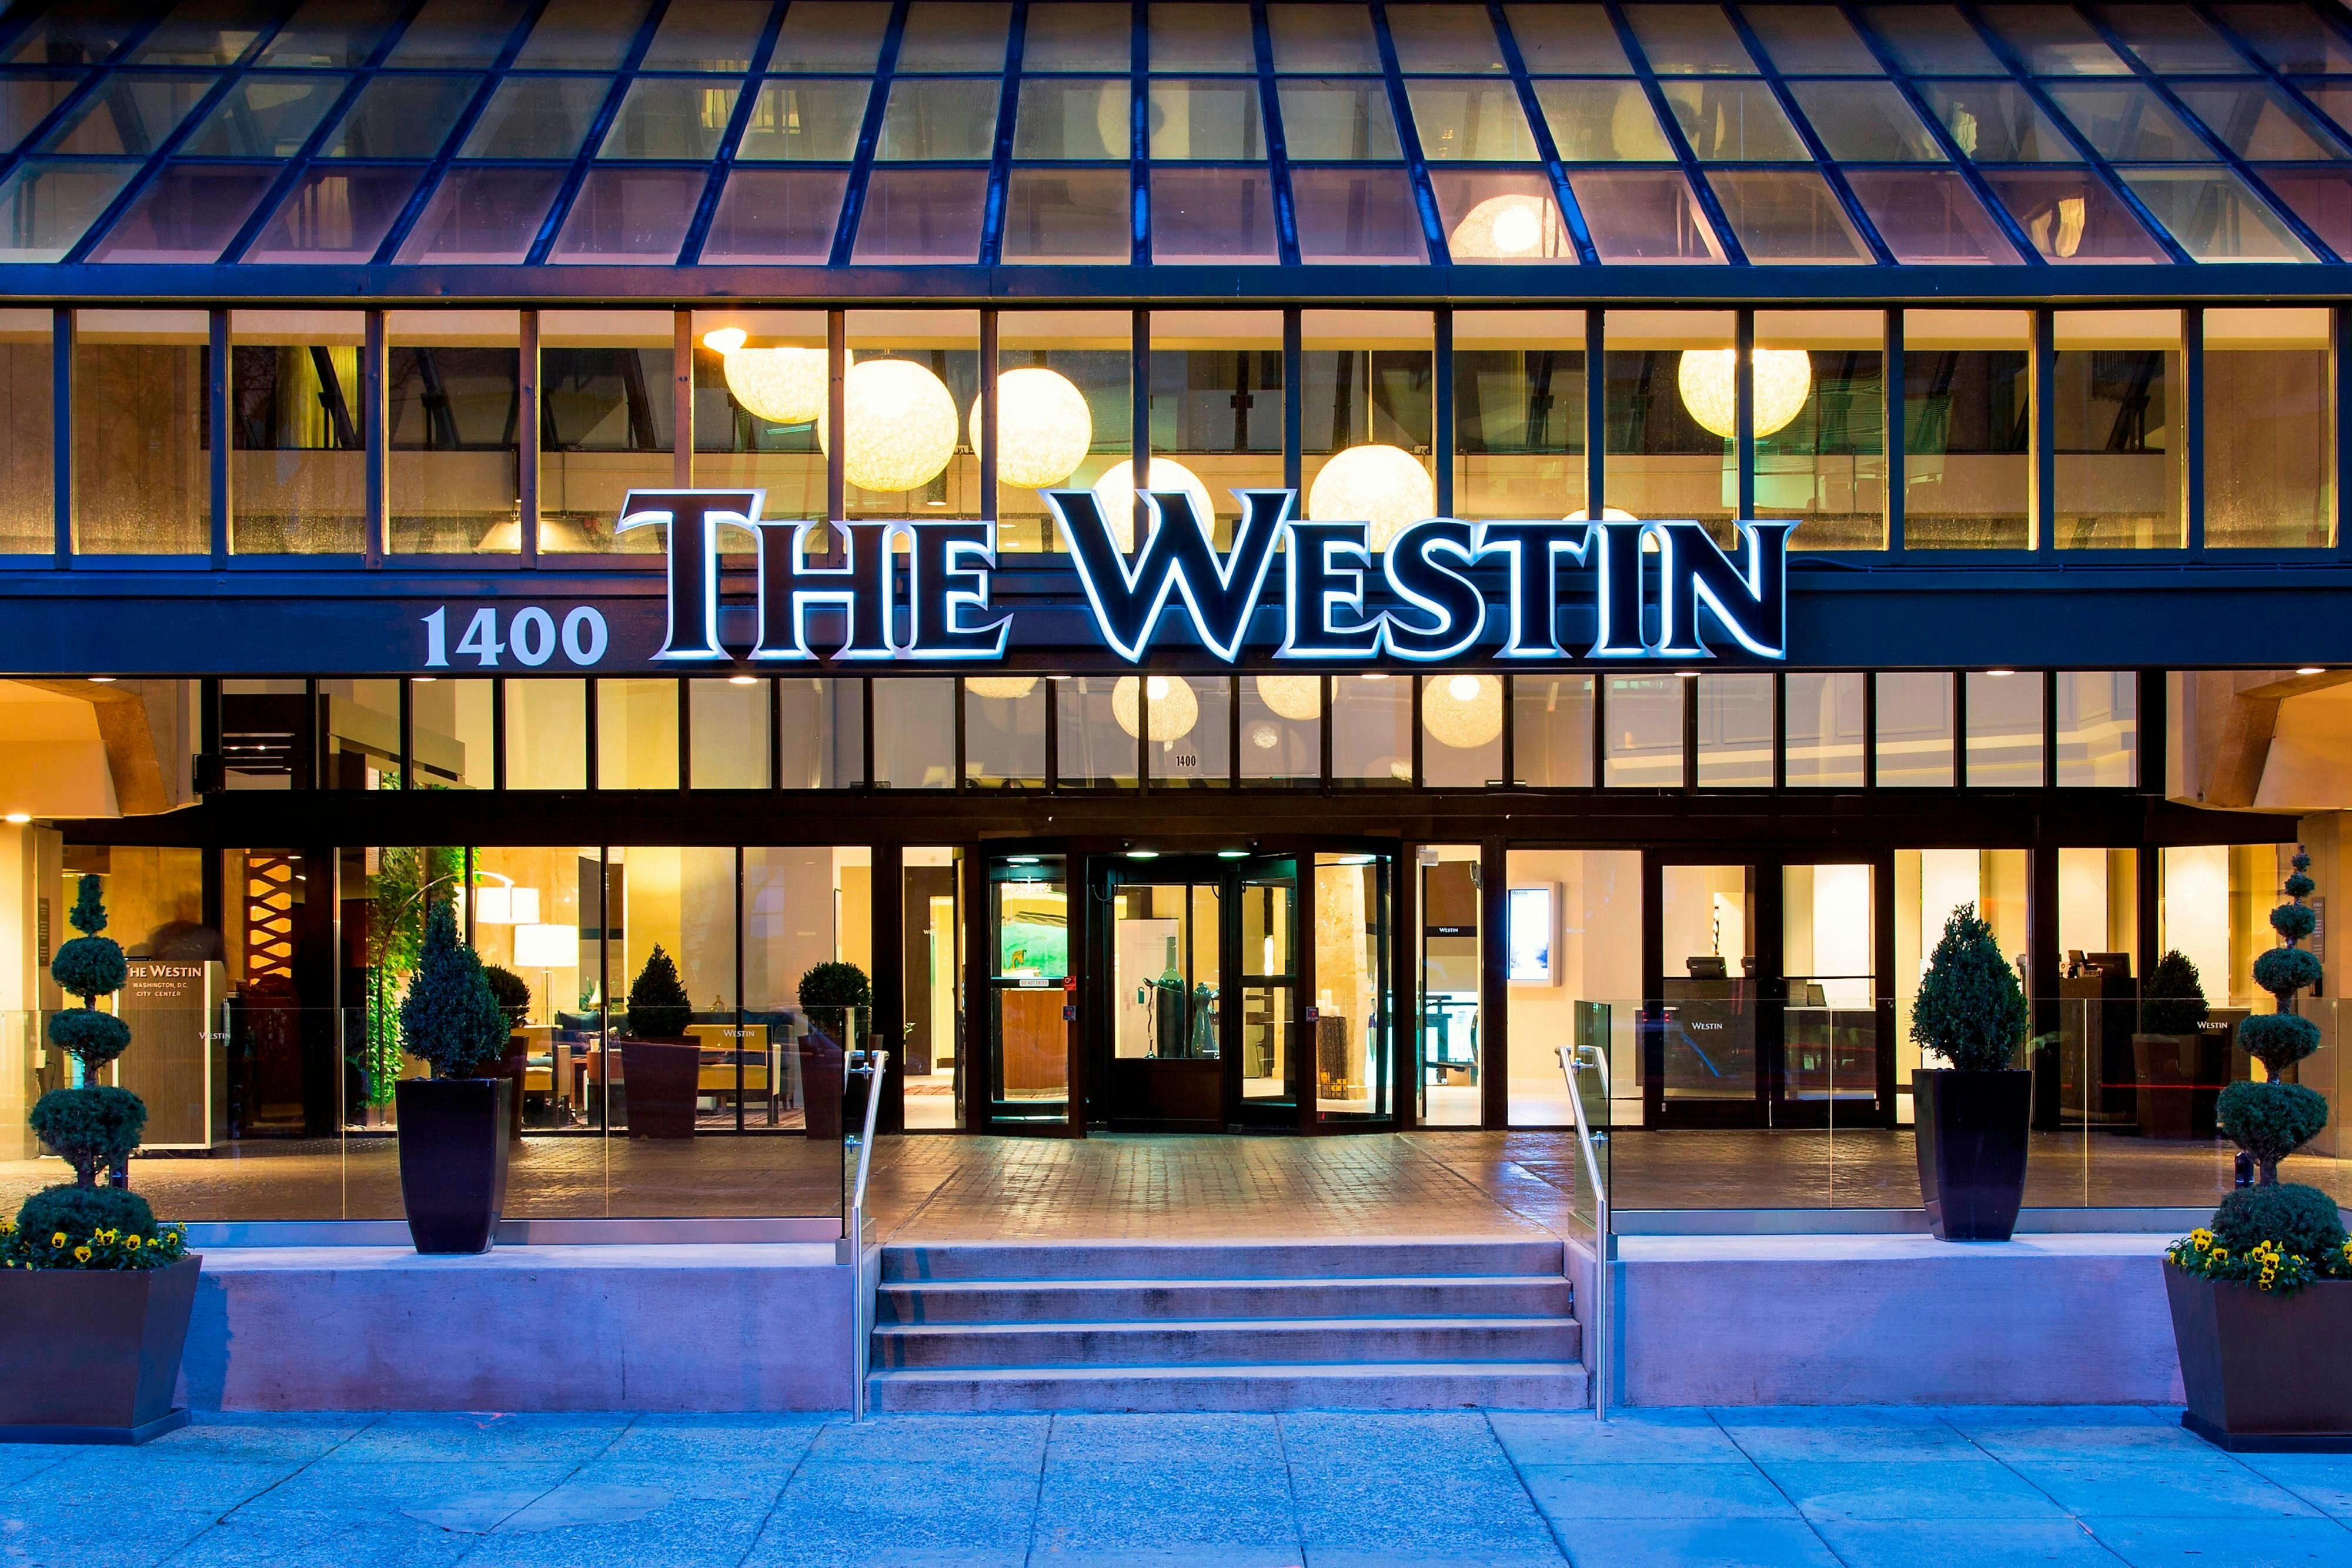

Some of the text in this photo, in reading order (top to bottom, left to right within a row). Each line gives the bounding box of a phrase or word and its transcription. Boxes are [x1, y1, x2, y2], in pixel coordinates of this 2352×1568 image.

[616, 487, 1801, 663] THE WESTIN
[420, 605, 608, 666] 1400
[1176, 755, 1197, 767] 1400
[126, 965, 202, 978] HE WESTIN
[1692, 1022, 1723, 1030] WESTIN
[2197, 1021, 2228, 1029] WESTIN
[723, 1029, 755, 1037] WESTIN
